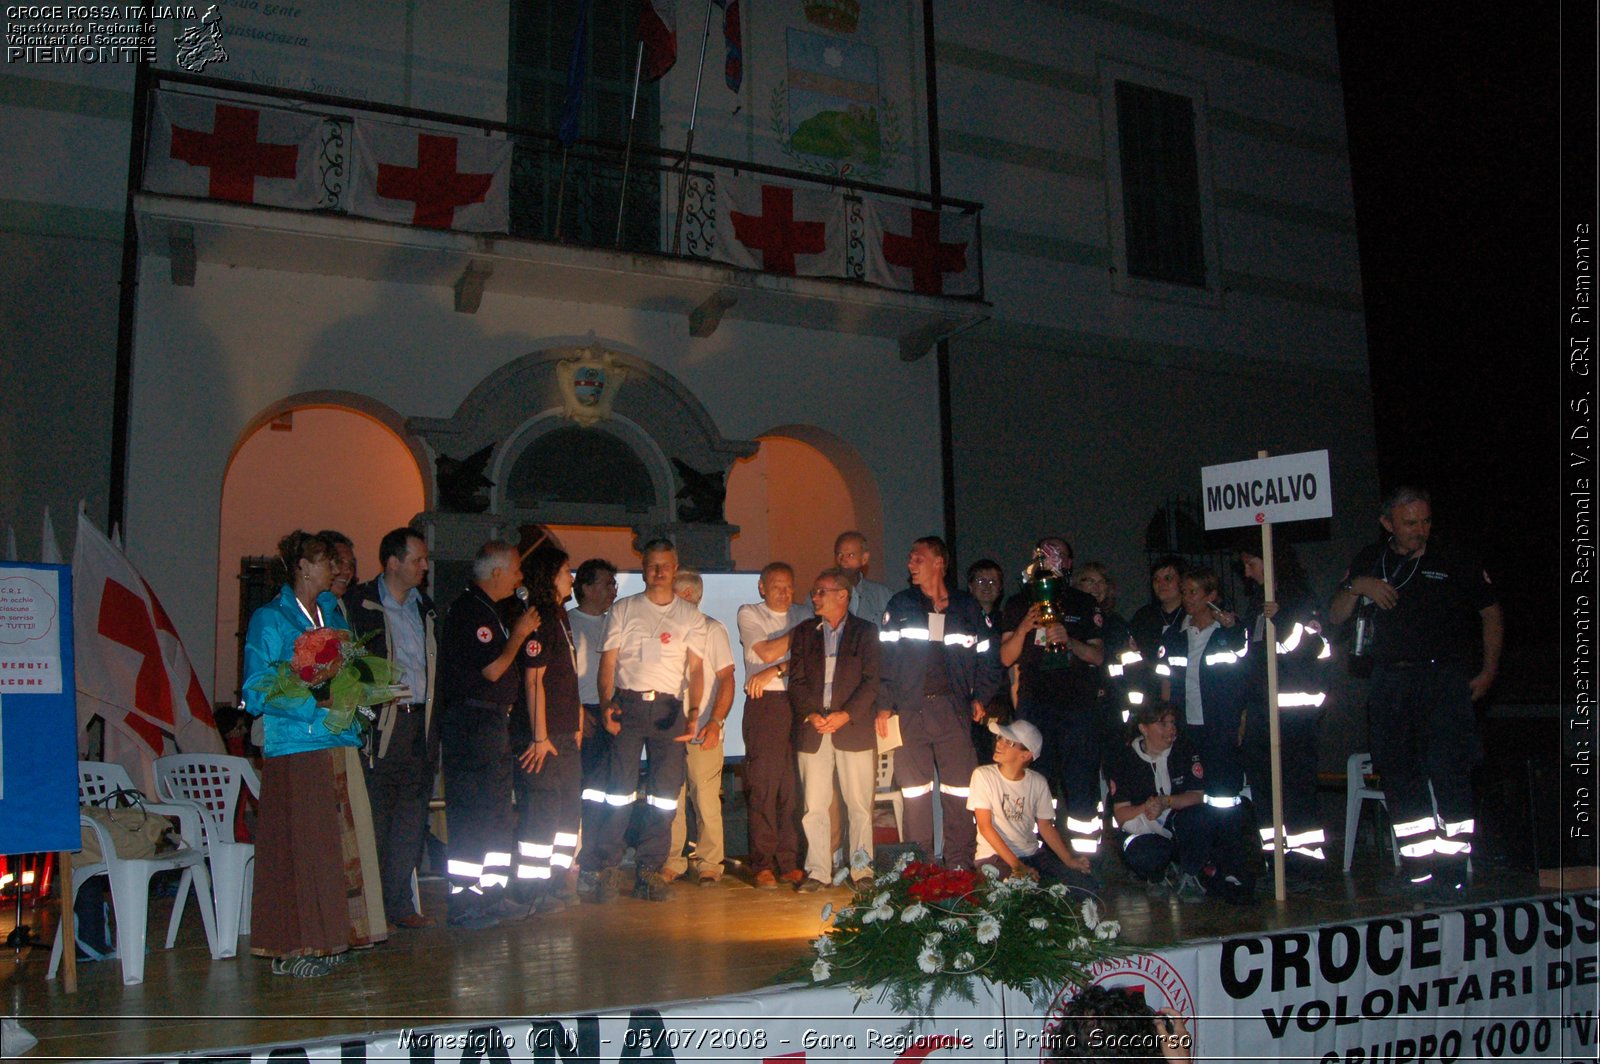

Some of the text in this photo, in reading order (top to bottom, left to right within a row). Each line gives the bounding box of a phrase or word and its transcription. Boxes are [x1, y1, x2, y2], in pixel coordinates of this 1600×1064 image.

[1207, 473, 1317, 512] MONCALVO
[1220, 913, 1441, 1000] CROCE
[1261, 965, 1533, 1039] VOLONTARI
[1471, 1017, 1551, 1060] 1000
